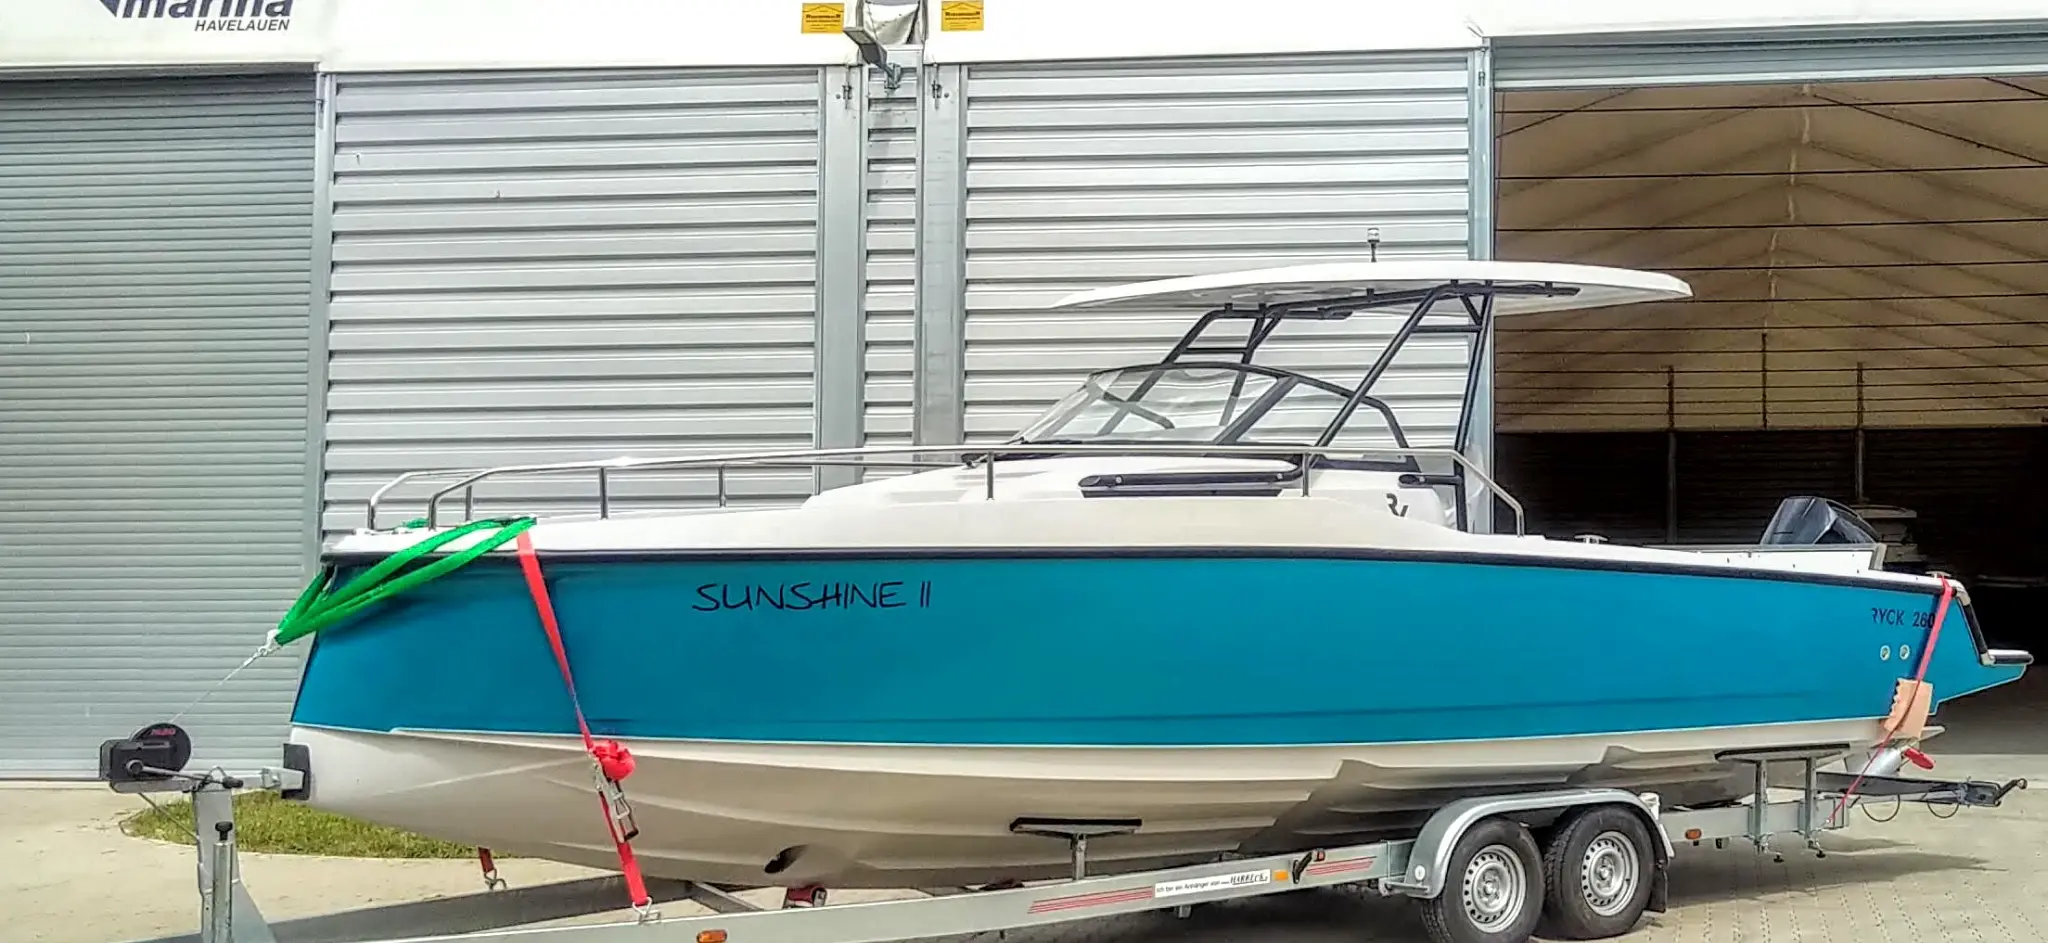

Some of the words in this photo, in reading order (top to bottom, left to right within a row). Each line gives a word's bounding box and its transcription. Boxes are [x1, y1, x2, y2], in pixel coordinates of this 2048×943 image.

[194, 19, 290, 31] HAVELAUEN
[692, 581, 907, 611] SUNSHINE
[1871, 607, 1905, 626] RYCK
